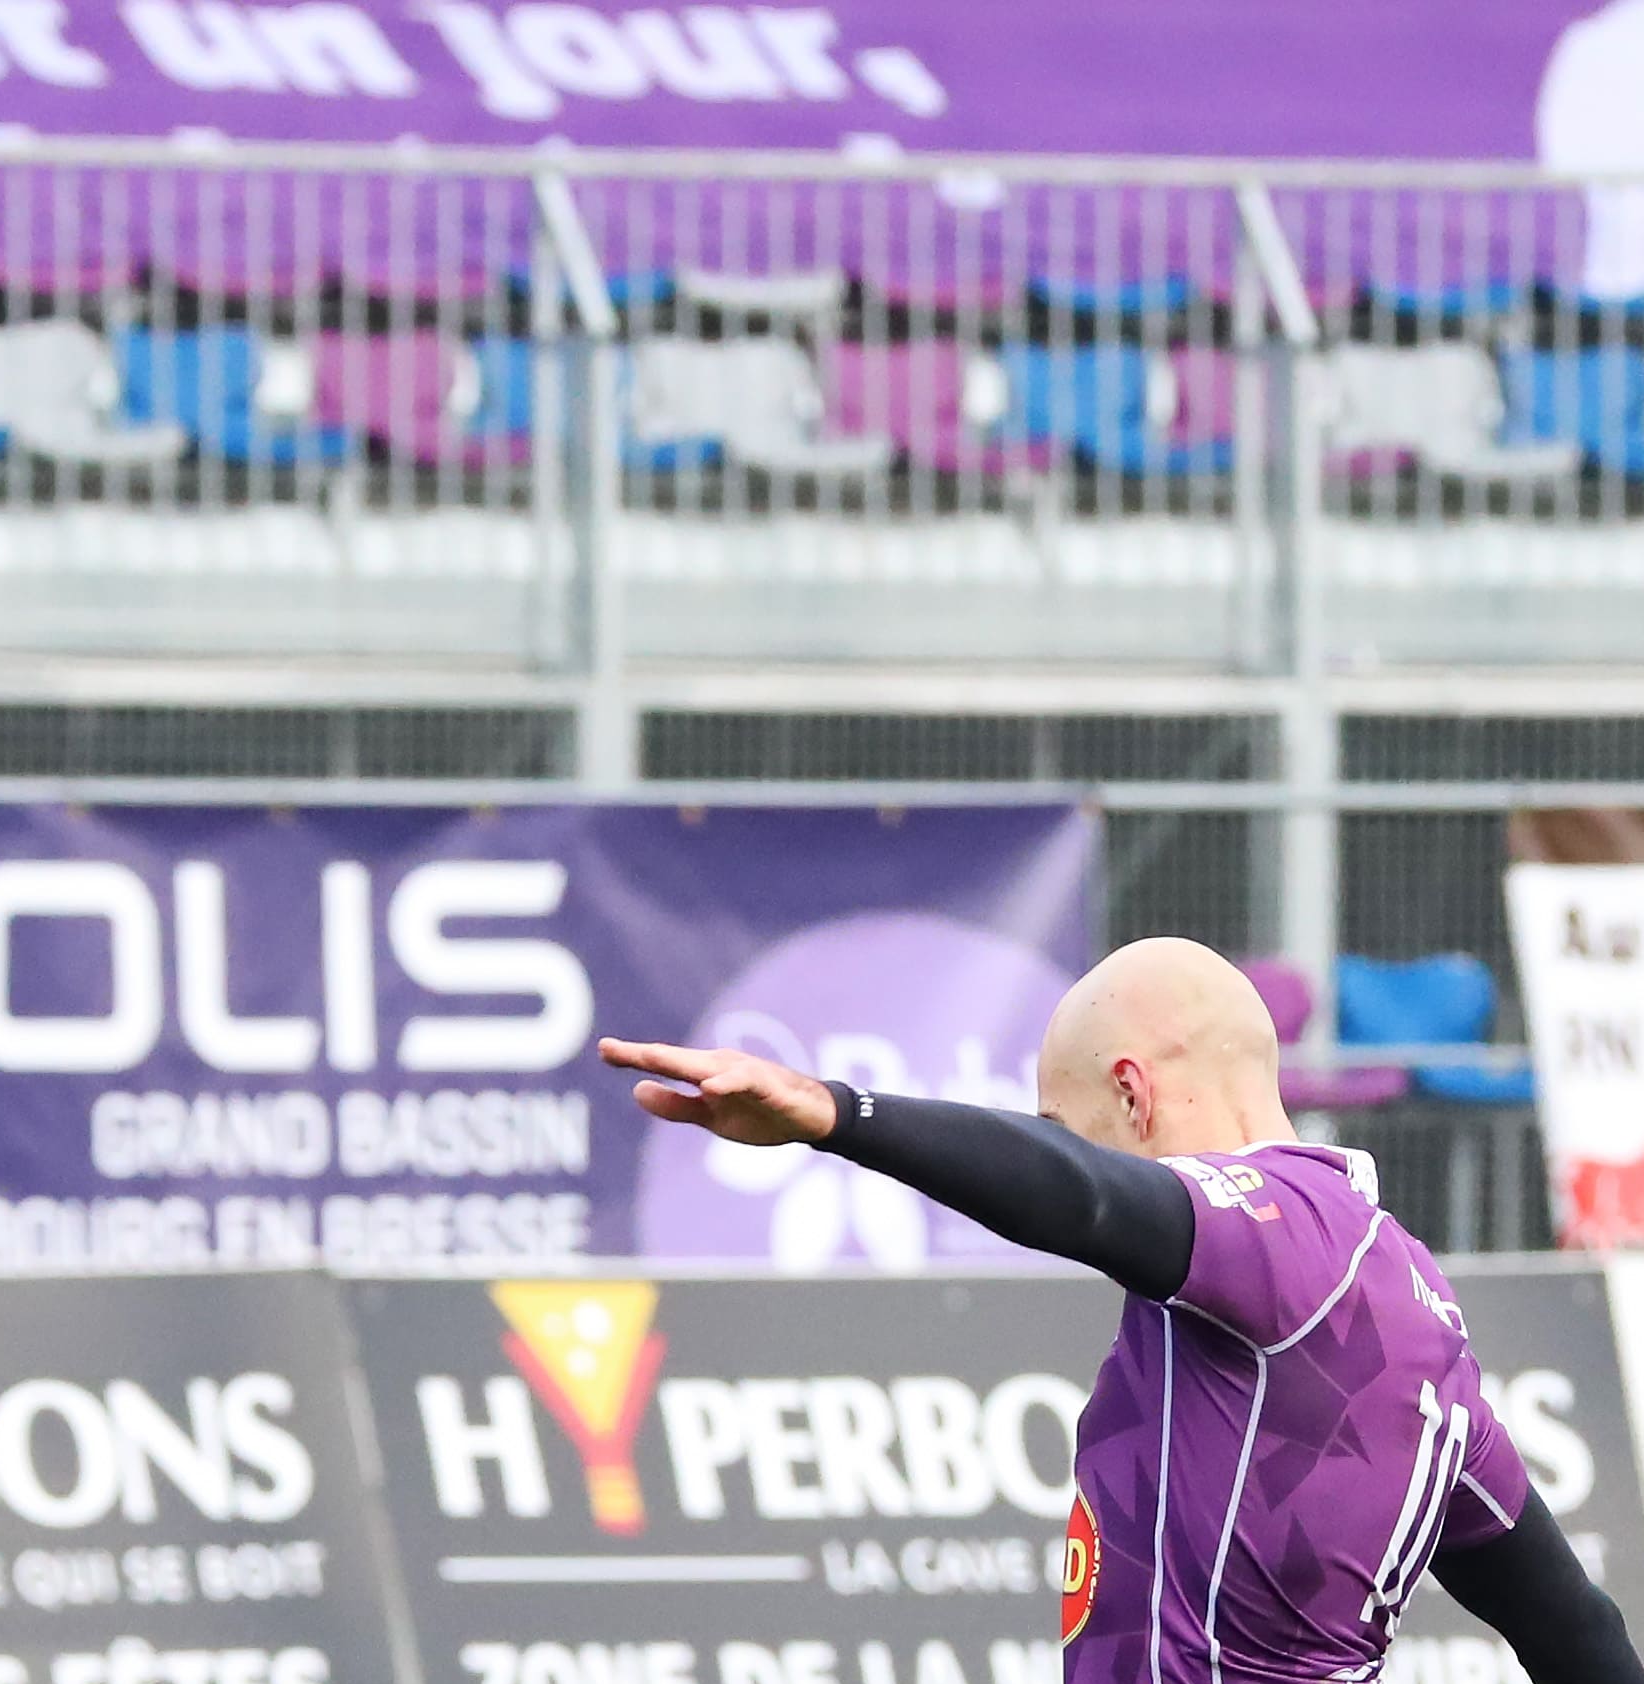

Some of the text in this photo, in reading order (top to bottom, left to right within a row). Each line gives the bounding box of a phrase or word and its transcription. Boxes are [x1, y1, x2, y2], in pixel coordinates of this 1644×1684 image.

[1561, 903, 1638, 962] Au
[91, 1090, 591, 1178] GRAND BASSIN
[320, 1194, 591, 1278] BRESSE
[12, 1546, 121, 1613] QUI
[124, 1544, 191, 1605] SE
[195, 1540, 324, 1602] BOIT
[819, 1536, 902, 1596] LA
[899, 1536, 1038, 1596] CAVE
